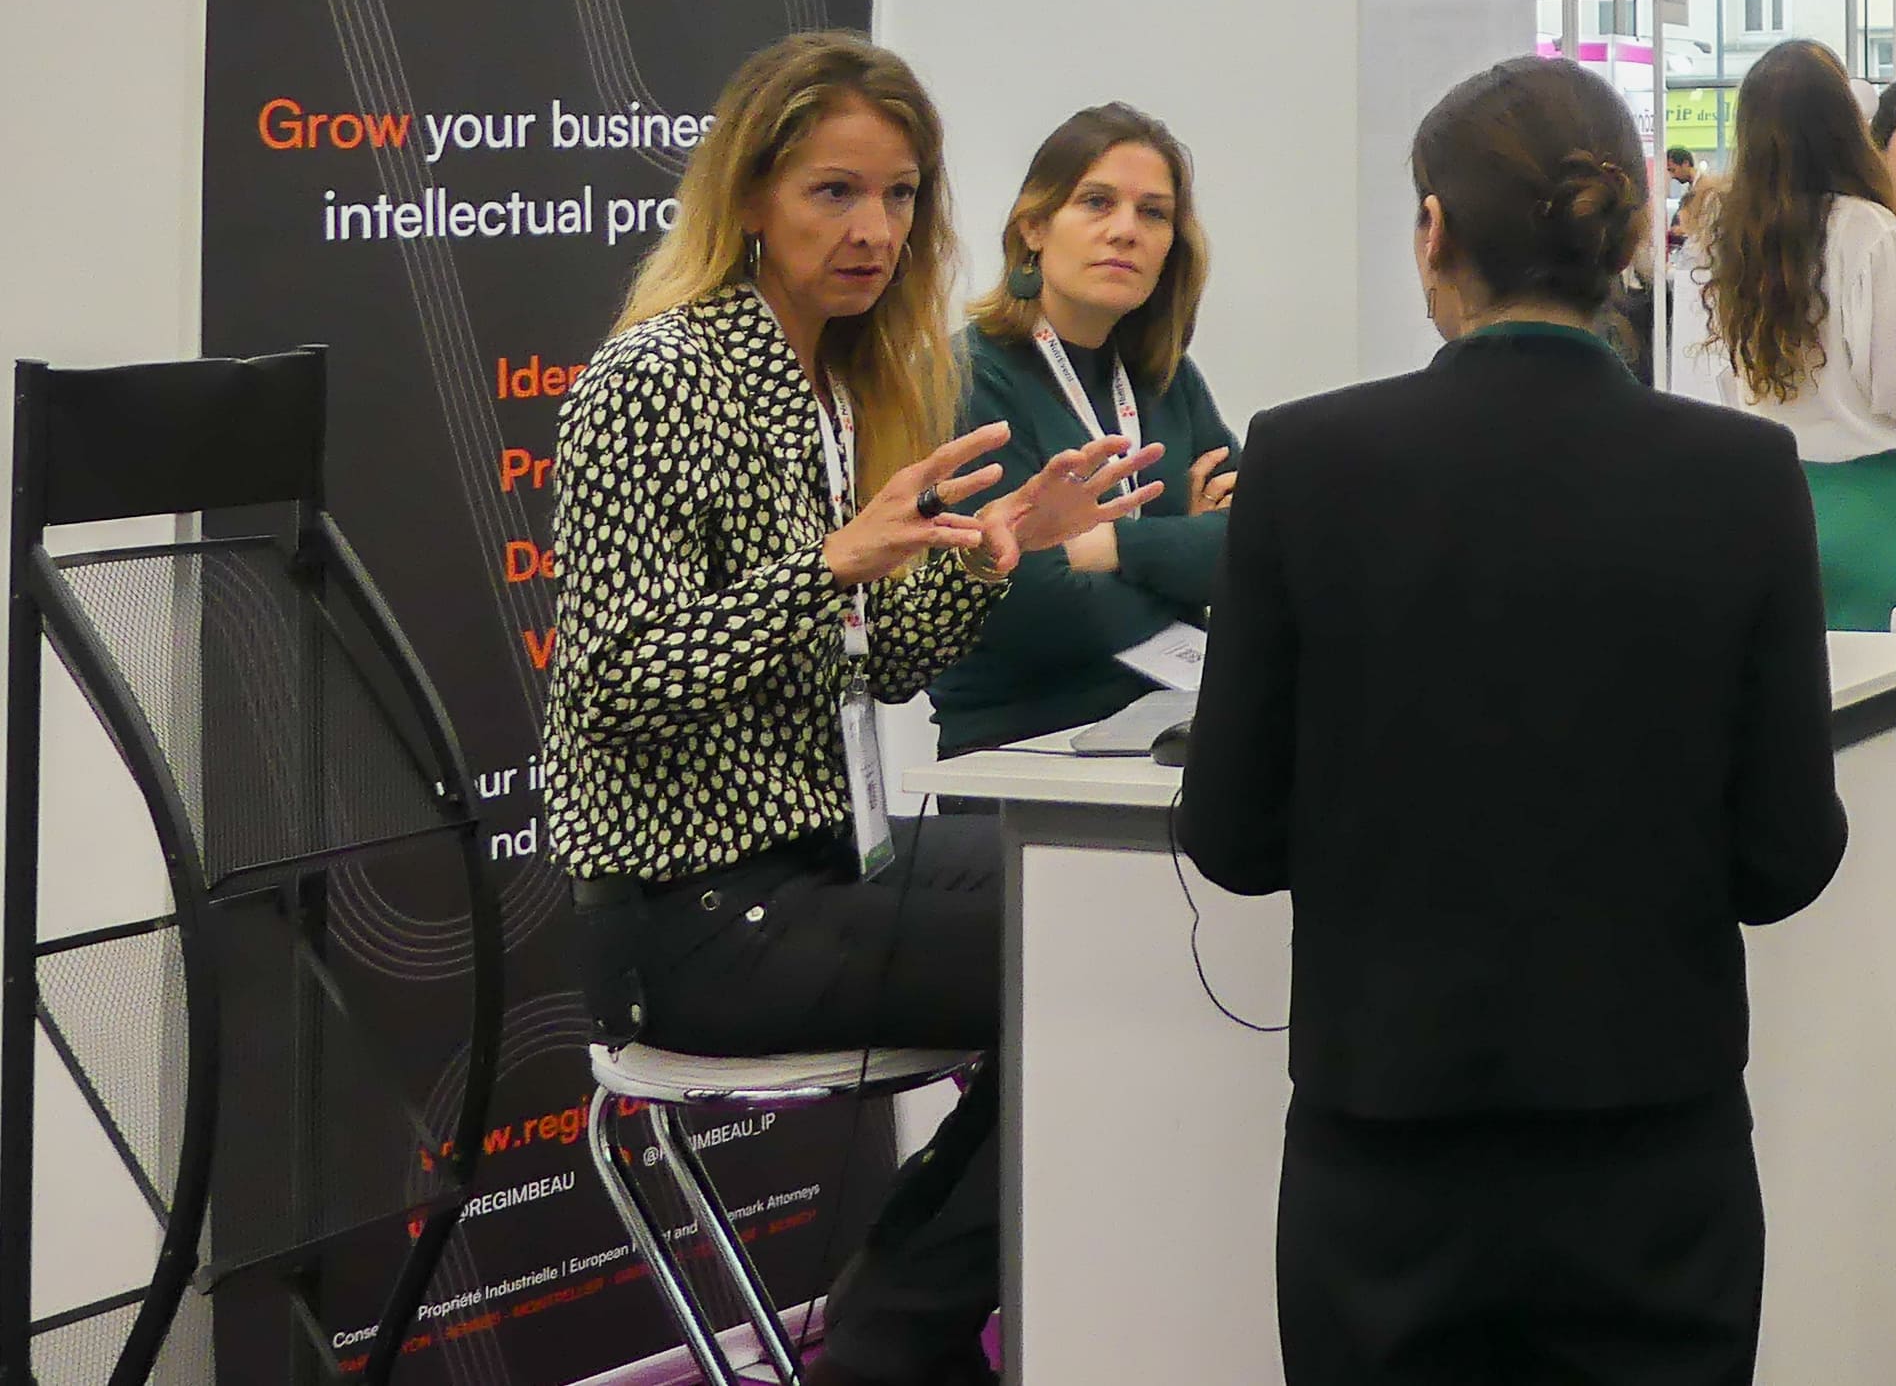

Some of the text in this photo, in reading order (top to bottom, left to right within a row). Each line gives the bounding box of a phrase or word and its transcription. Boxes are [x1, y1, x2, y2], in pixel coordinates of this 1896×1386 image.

[258, 98, 717, 163] Grow your busines
[1666, 105, 1692, 121] rie
[325, 185, 682, 245] intellectual pro
[497, 355, 587, 399] Iden
[491, 818, 537, 860] nd
[675, 1221, 698, 1239] and
[767, 1183, 821, 1209] Attorneys
[332, 1324, 380, 1349] Conse
[418, 1288, 482, 1321] Propriété
[485, 1267, 558, 1299] Industrielle
[570, 1244, 628, 1275] European
